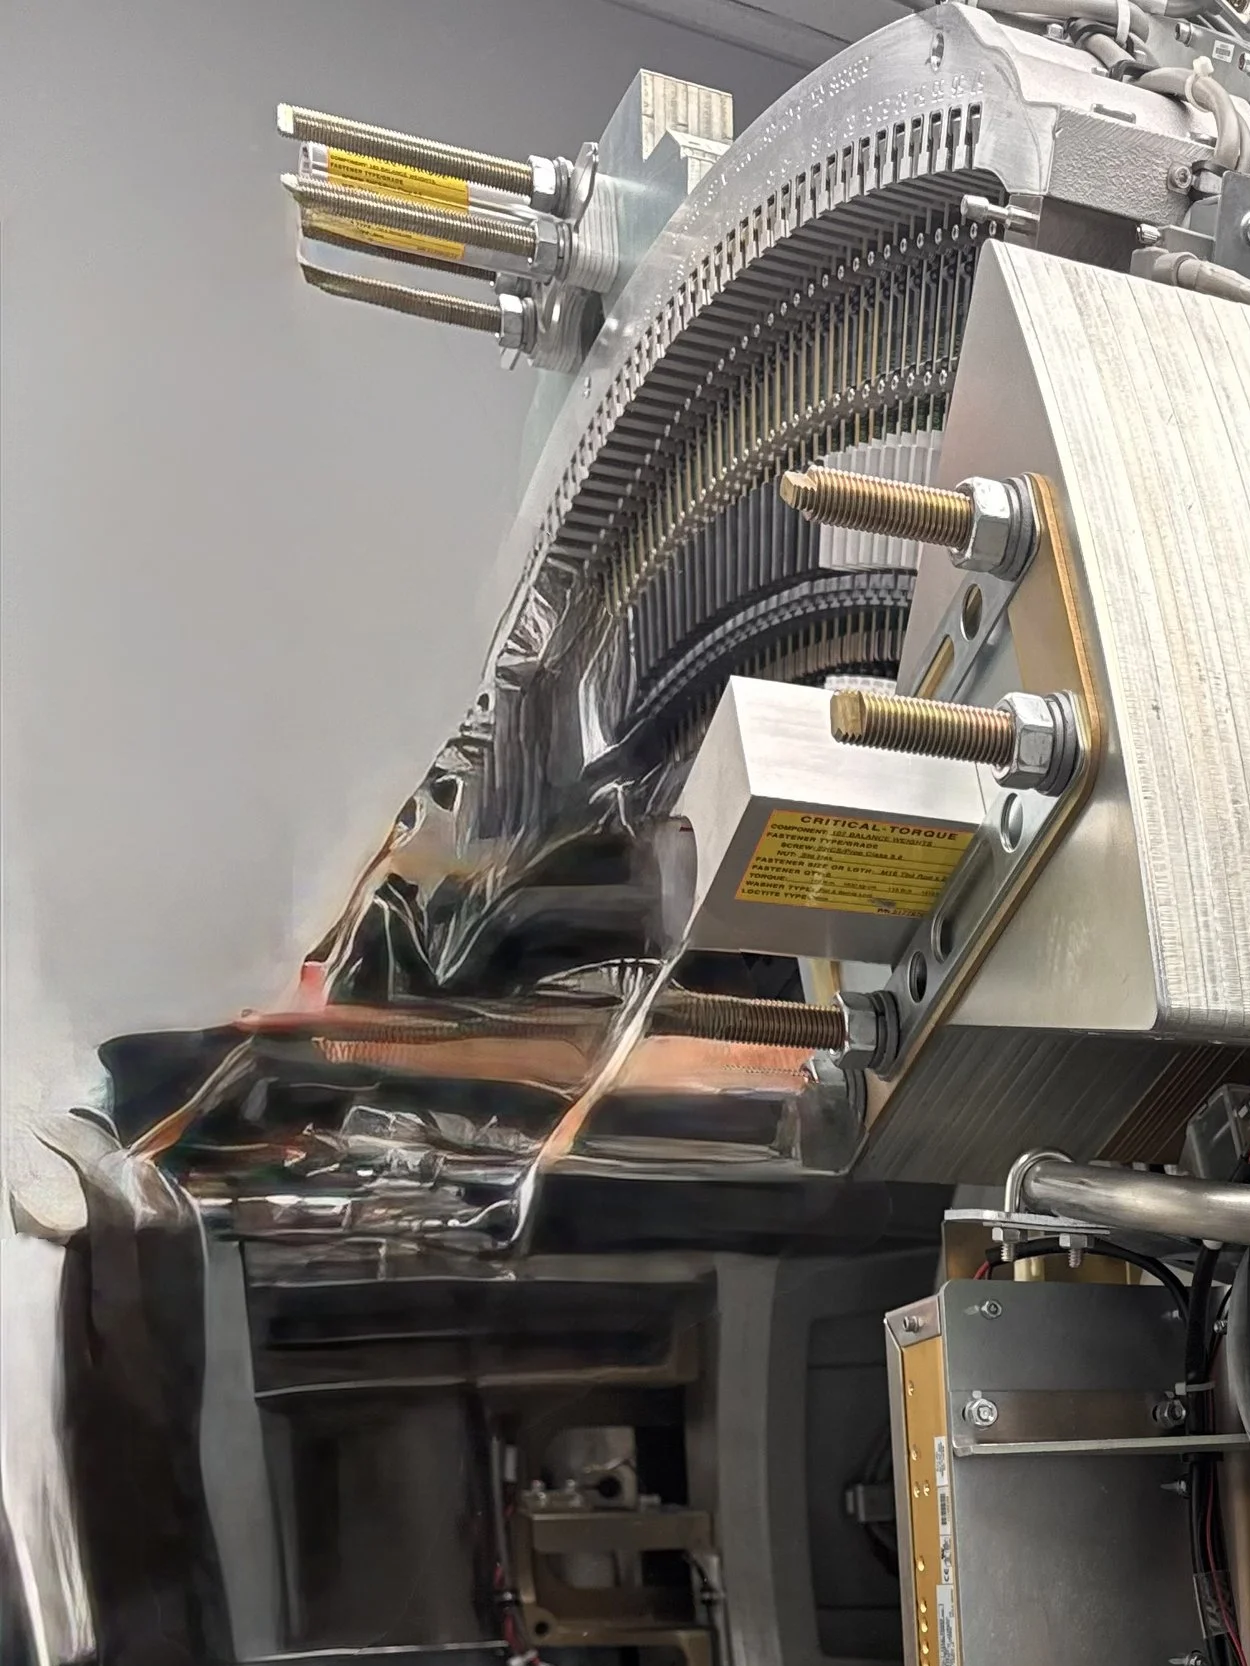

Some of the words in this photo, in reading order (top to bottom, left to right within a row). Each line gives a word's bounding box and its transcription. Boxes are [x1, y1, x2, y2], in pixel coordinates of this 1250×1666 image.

[767, 832, 816, 842] FASTENER
[755, 856, 805, 867] FASTENER
[751, 864, 801, 875] FASTENER
[745, 880, 785, 890] WASHER
[741, 888, 781, 898] LOCTITE
